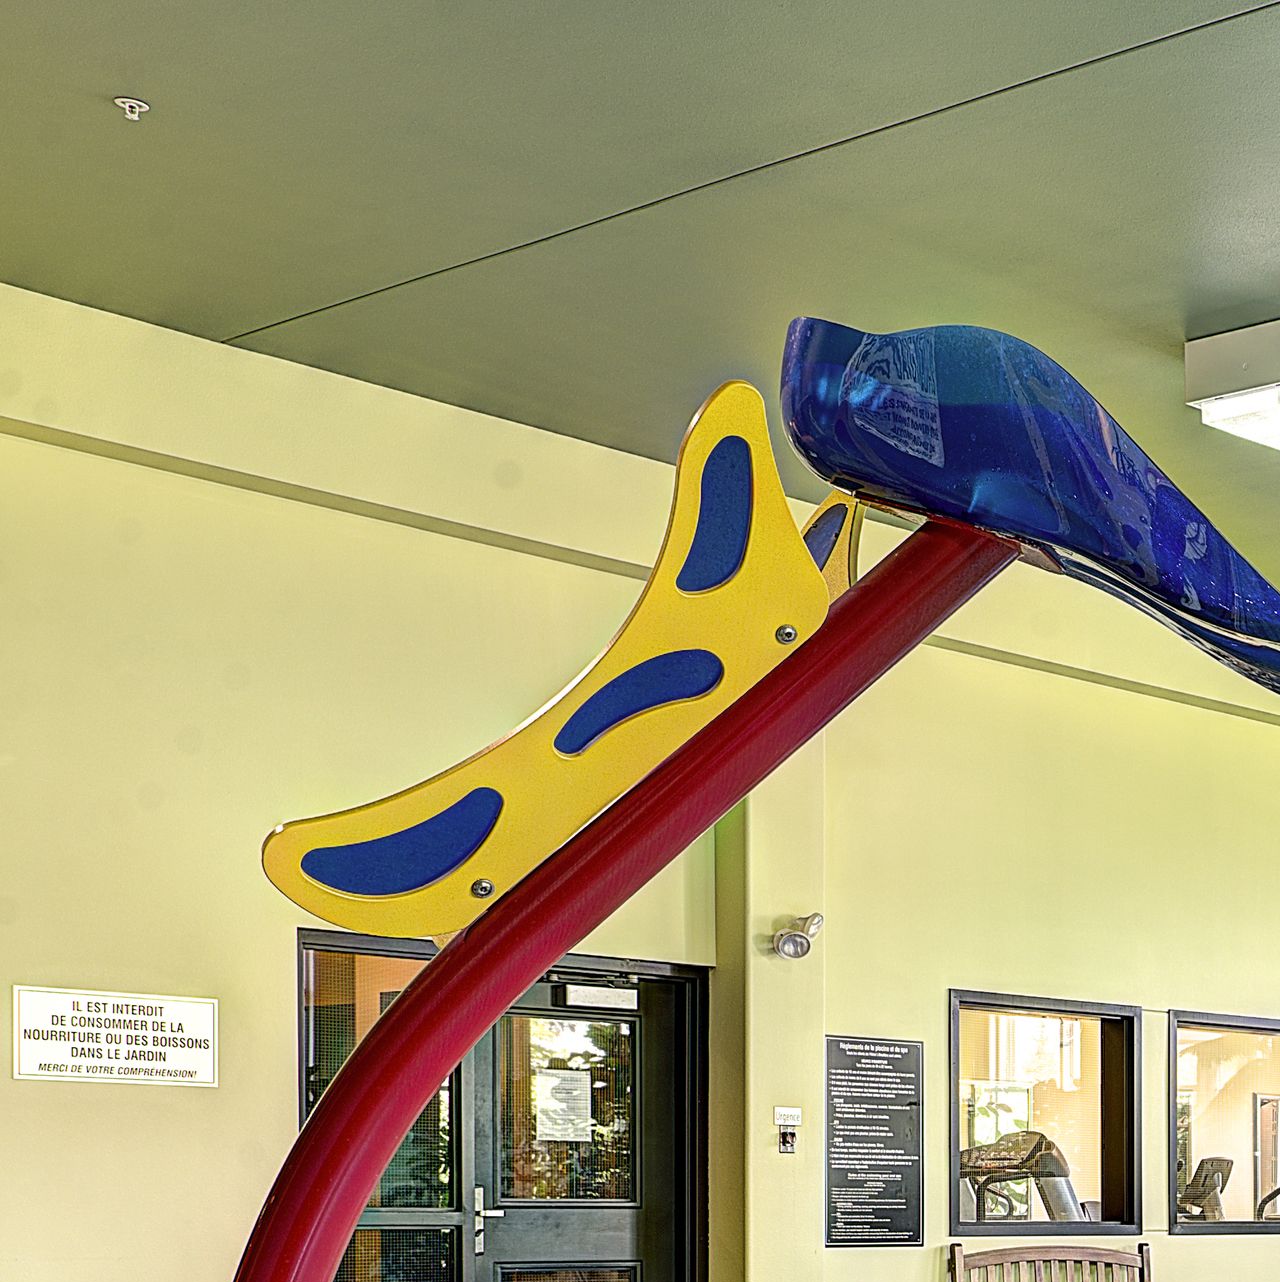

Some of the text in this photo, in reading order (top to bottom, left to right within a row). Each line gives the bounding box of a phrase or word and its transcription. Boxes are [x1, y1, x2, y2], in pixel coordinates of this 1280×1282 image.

[72, 1001, 164, 1017] IL EST INTERDIT
[51, 1015, 184, 1033] DE CONSOMMER DE LA
[24, 1029, 210, 1049] NOURRITURE OU DES BOISSONS
[71, 1047, 166, 1061] DANS LE JARDIN
[38, 1063, 197, 1078] MERCI DE VOTRE COMPRÉHENSION!
[776, 1111, 800, 1123] Urgence
